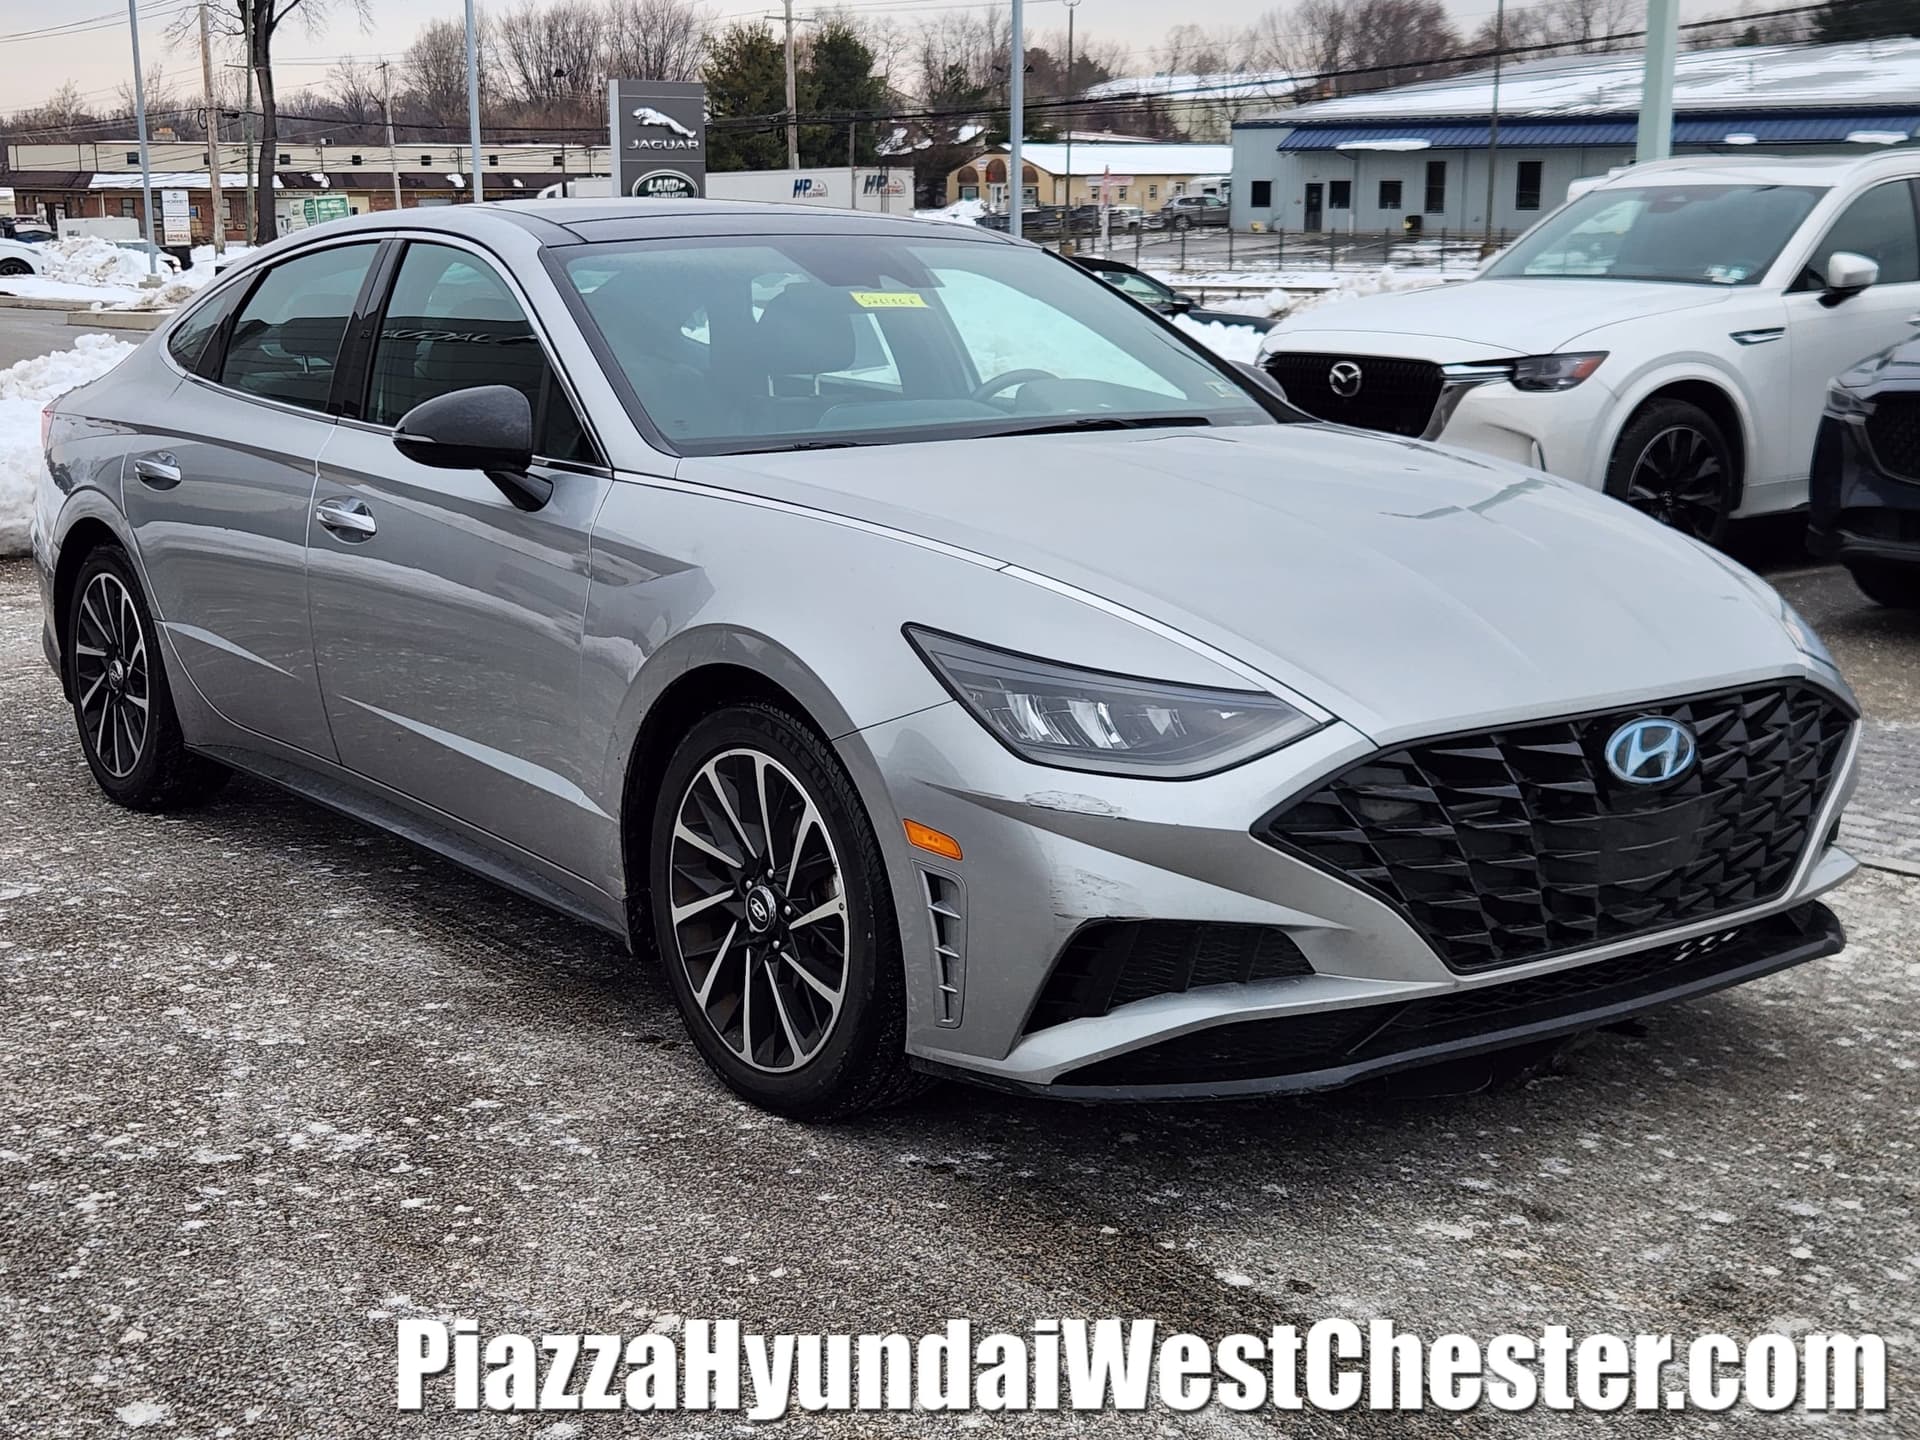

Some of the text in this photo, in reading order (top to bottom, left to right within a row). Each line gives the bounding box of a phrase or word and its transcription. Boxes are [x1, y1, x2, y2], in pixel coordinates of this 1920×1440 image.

[627, 139, 700, 150] JAGUAR
[792, 179, 812, 198] HP
[863, 175, 888, 194] HP
